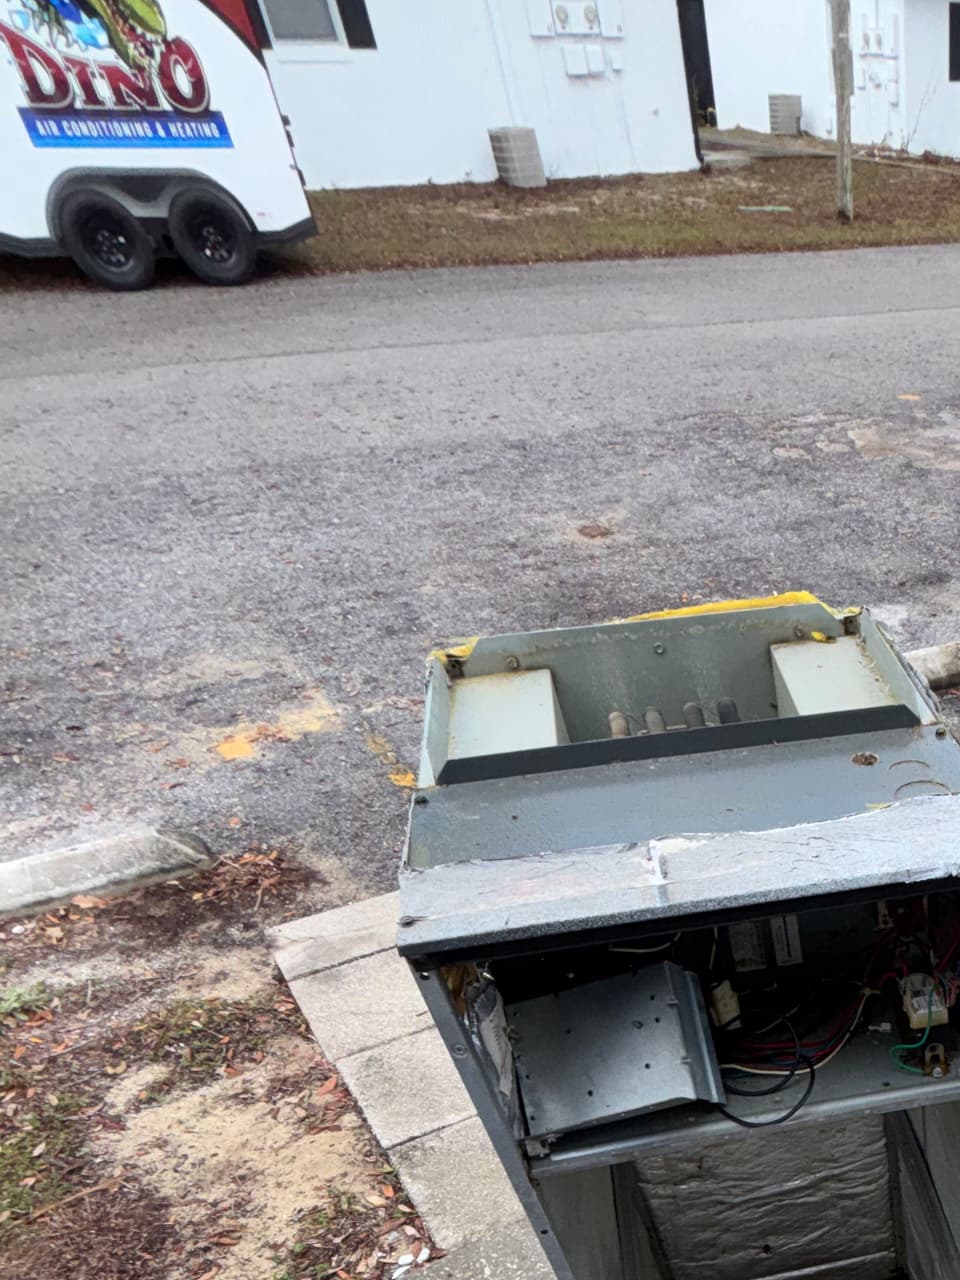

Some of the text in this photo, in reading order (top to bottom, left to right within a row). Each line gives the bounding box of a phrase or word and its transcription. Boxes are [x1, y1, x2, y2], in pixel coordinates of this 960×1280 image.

[0, 22, 210, 113] DINO
[35, 120, 221, 138] AIR CONDITIONING & HEATING
